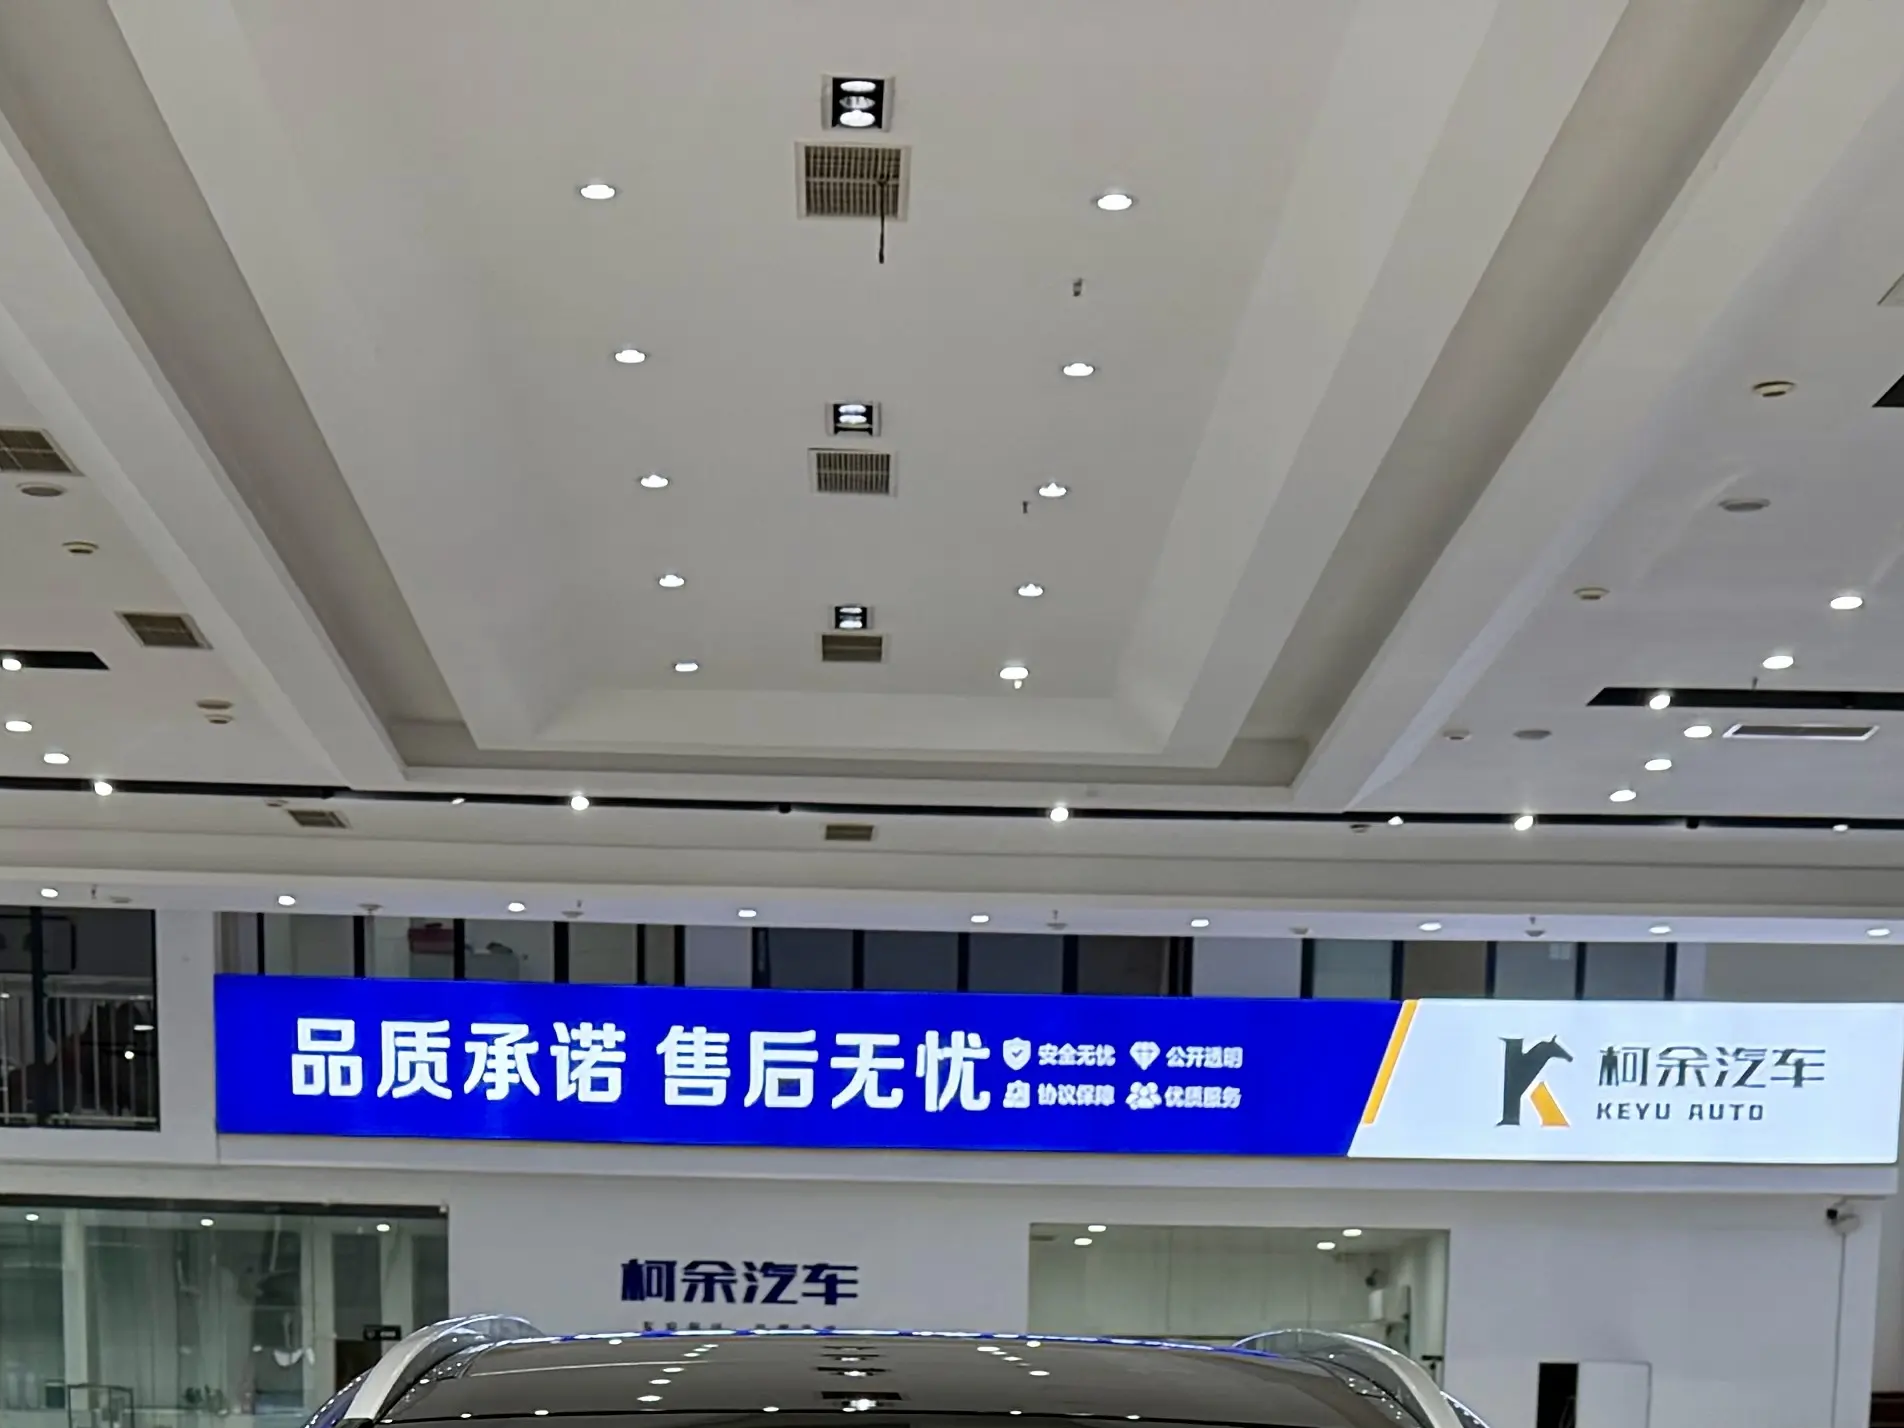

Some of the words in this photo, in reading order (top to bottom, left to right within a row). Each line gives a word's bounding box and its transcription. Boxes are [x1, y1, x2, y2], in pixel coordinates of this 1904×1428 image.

[291, 1018, 626, 1102] 品质承诺
[656, 1025, 991, 1112] 售后无忧
[1038, 1043, 1116, 1066] 安全无忧
[1598, 1046, 1826, 1088] 柯余汽车
[1596, 1103, 1671, 1121] KEYU
[1688, 1104, 1764, 1121] AUTO
[620, 1258, 859, 1305] 柯余汽车
